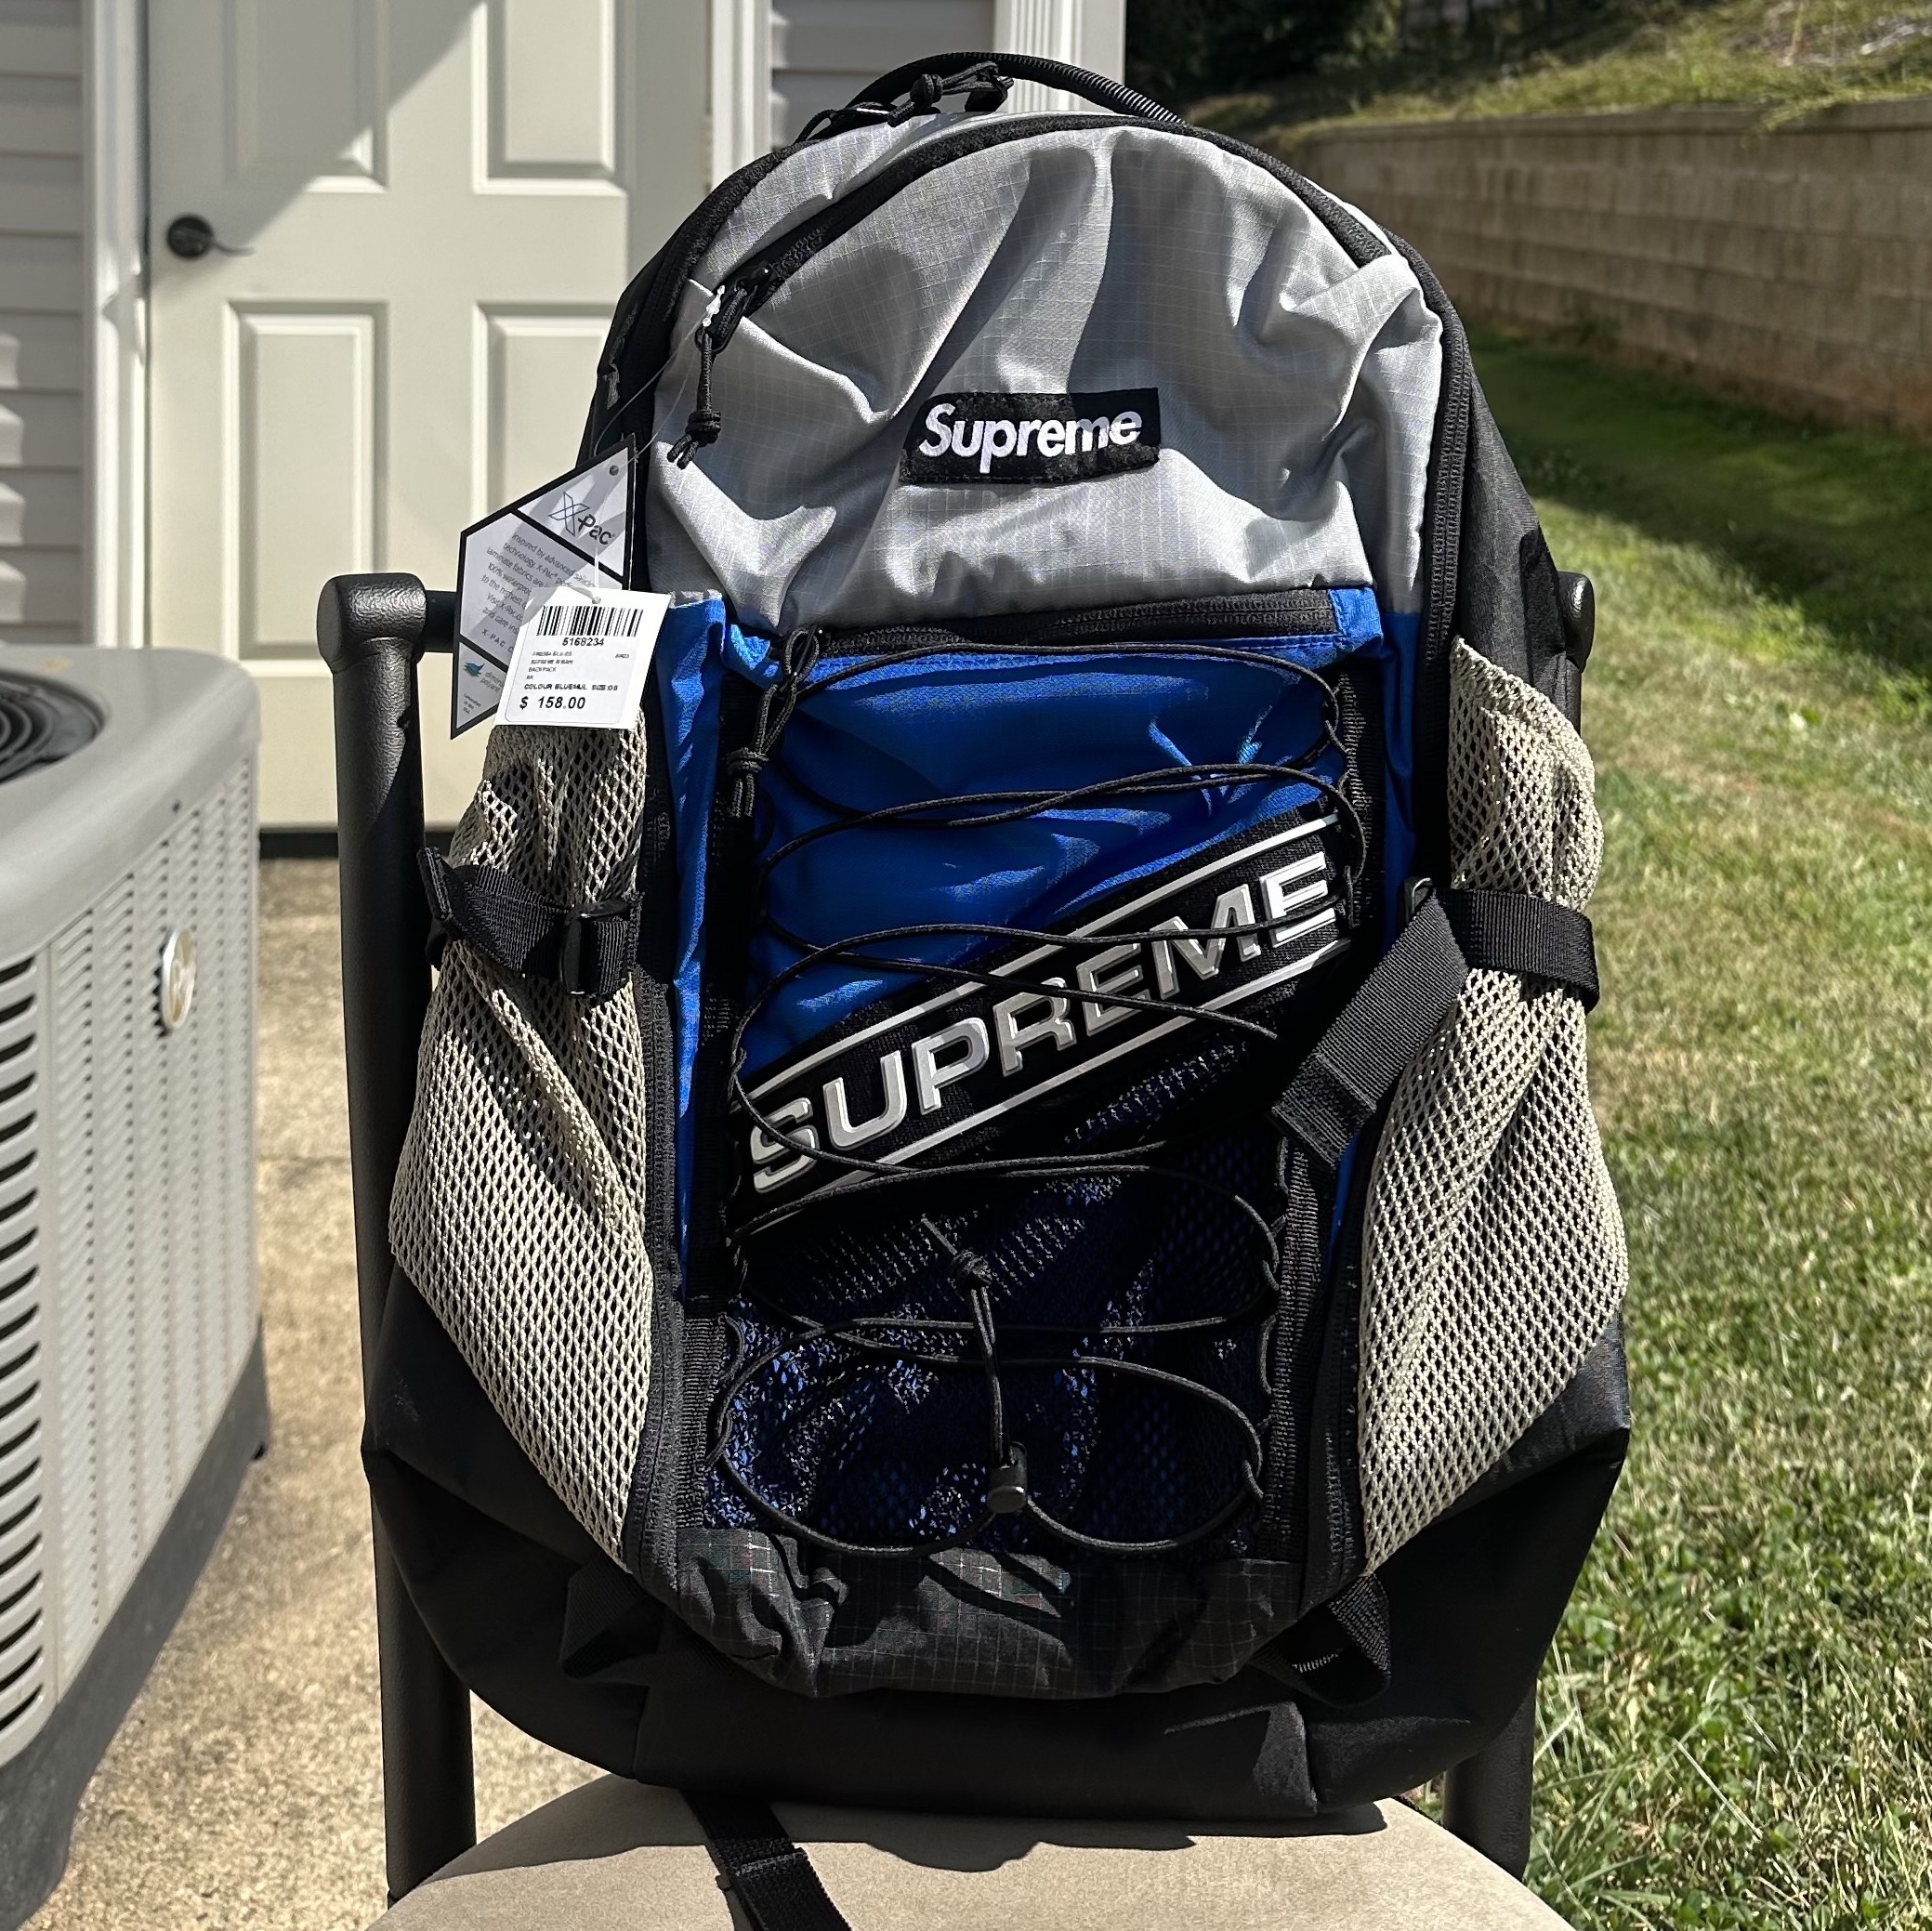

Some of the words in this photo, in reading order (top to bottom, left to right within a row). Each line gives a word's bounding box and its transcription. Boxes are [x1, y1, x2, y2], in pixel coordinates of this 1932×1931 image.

[919, 403, 1142, 474] Supreme
[536, 547, 545, 558] by
[545, 554, 575, 576] advanced
[481, 573, 490, 584] to
[490, 578, 501, 591] the
[562, 637, 605, 647] 5168234
[519, 696, 529, 710] $
[537, 696, 586, 709] 158.00
[749, 850, 1336, 1194] SUPREME
